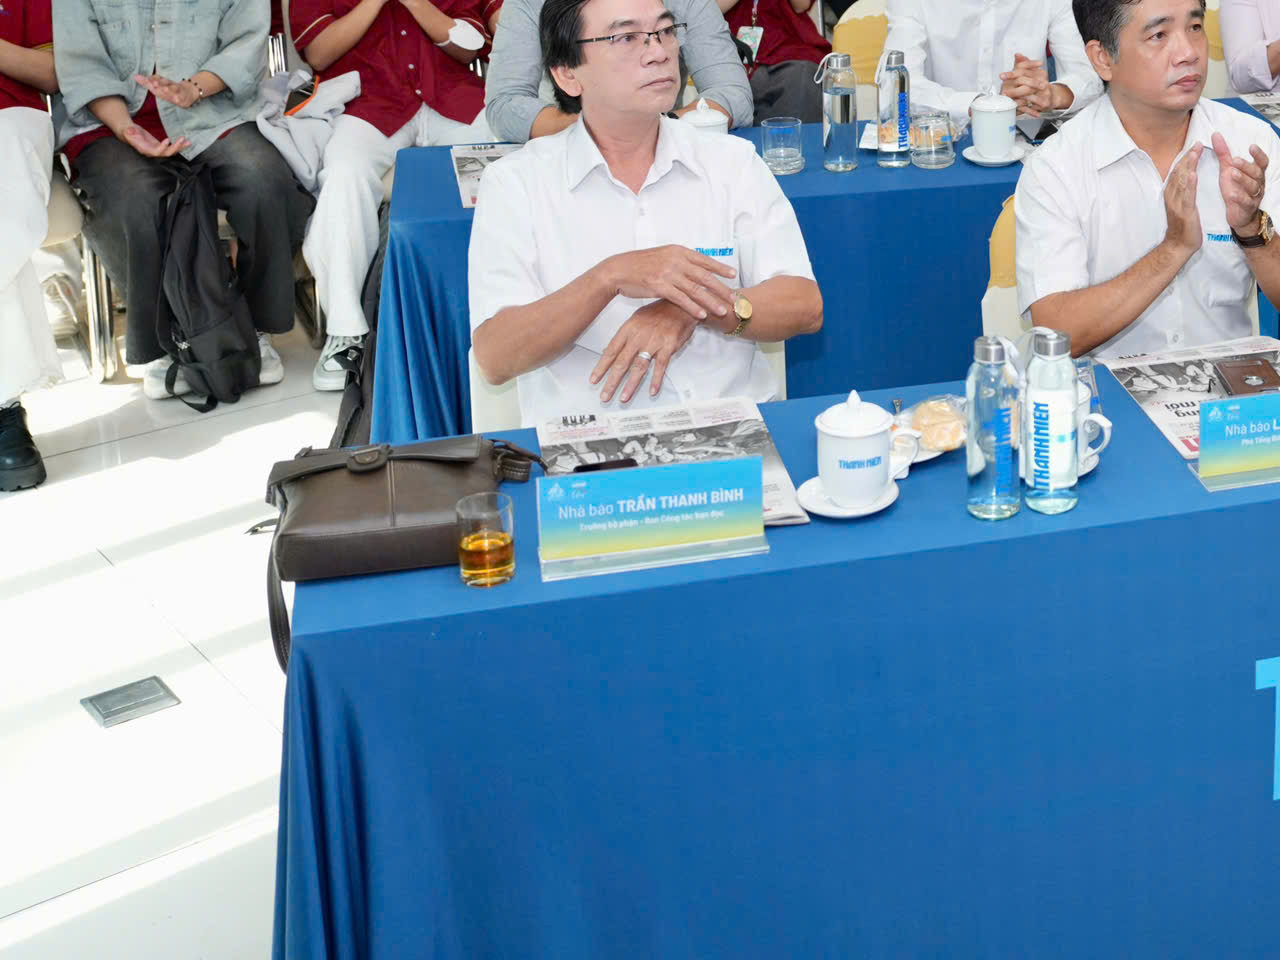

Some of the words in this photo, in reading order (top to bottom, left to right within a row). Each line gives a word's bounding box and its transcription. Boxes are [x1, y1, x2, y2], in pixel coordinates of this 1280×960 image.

[1225, 424, 1247, 437] Nhà
[1250, 421, 1270, 434] báo
[1033, 437, 1049, 489] THANH
[559, 503, 586, 520] Nhà
[589, 502, 614, 518] báo
[660, 492, 707, 509] THANH
[711, 487, 744, 504] BÌNH
